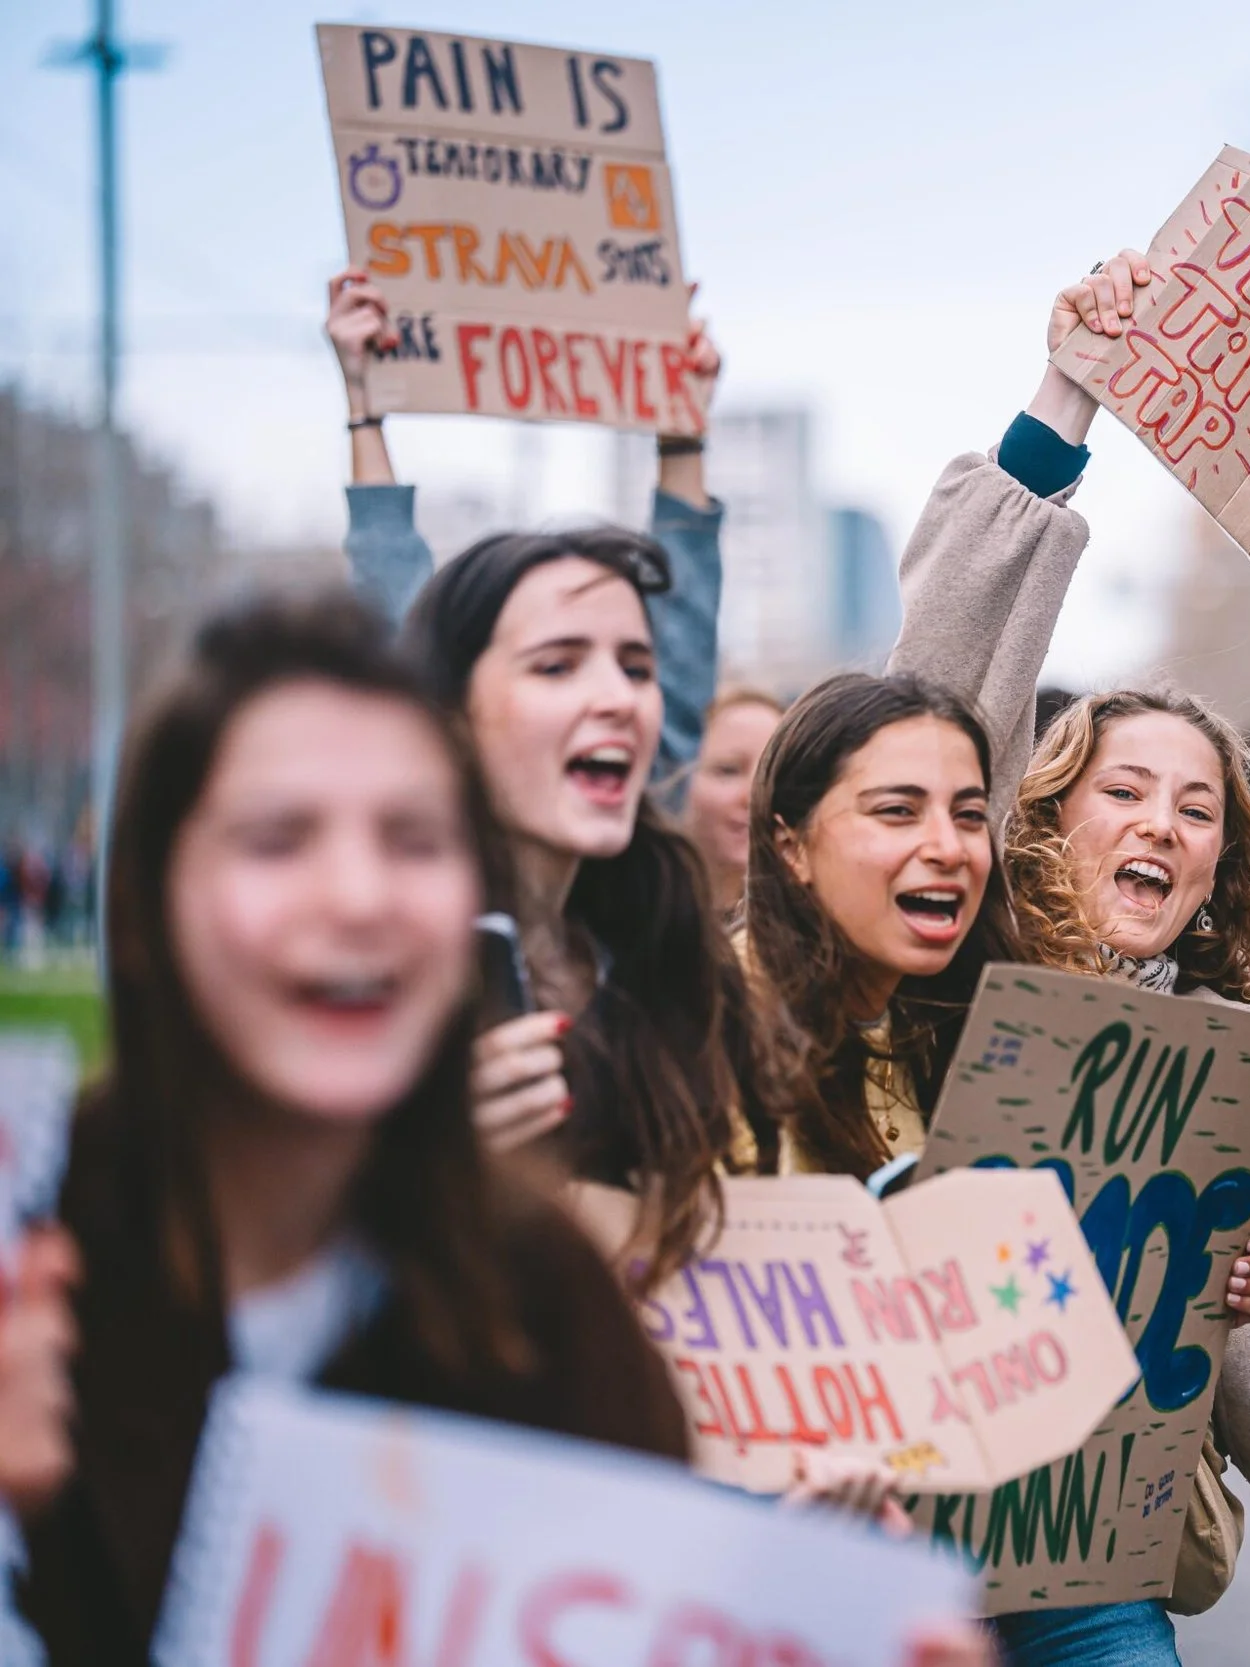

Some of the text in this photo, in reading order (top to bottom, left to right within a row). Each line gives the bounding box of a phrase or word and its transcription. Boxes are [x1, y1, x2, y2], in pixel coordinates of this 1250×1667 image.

[360, 30, 630, 133] PAIN IS
[396, 138, 591, 193] TEMPORARY
[367, 222, 670, 293] STRAVA STATS
[457, 323, 705, 434] FOREVER
[1107, 330, 1236, 464] TAP
[1061, 1021, 1215, 1166] RUN
[850, 1260, 980, 1344] RUN
[930, 1329, 1068, 1426] ONLY
